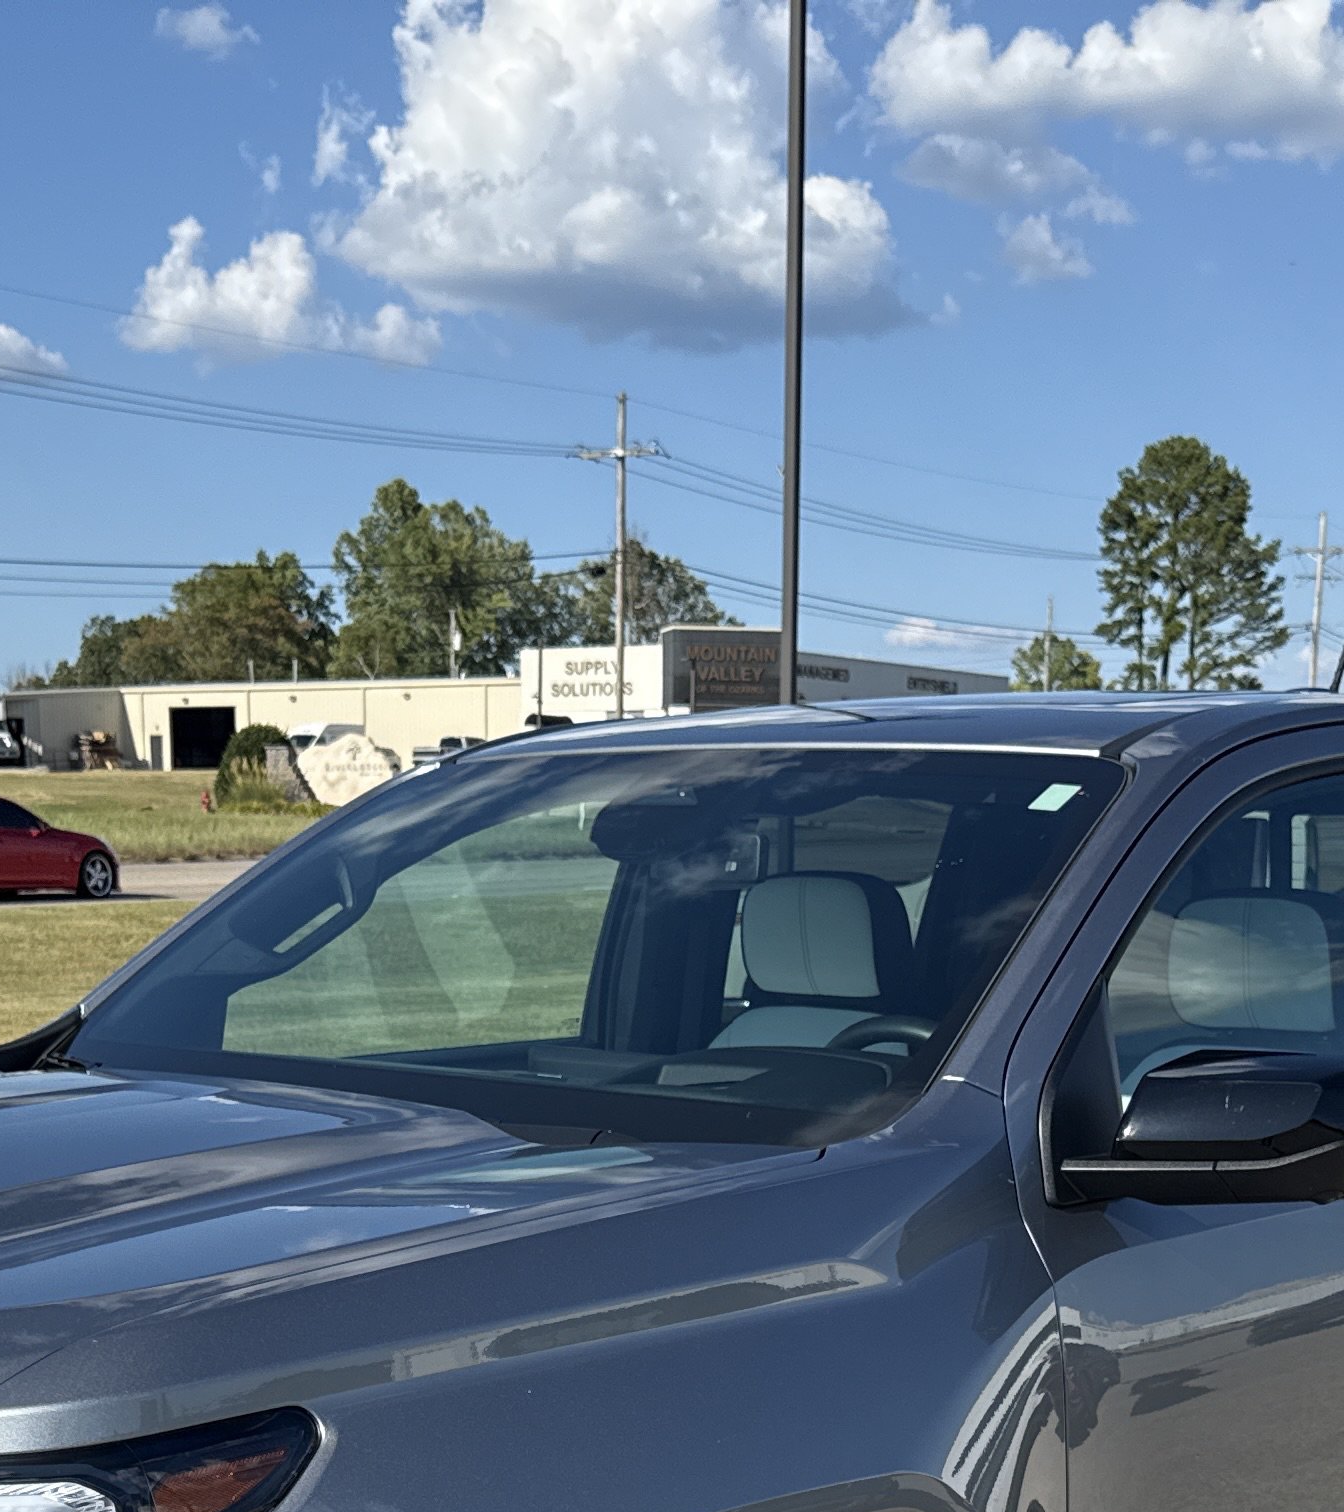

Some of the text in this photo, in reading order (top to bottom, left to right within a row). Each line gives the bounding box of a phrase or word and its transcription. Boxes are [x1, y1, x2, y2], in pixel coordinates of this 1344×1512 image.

[687, 645, 777, 664] MOUNTAIN
[695, 665, 766, 682] VALLEY
[551, 681, 633, 698] SOLUTIOS
